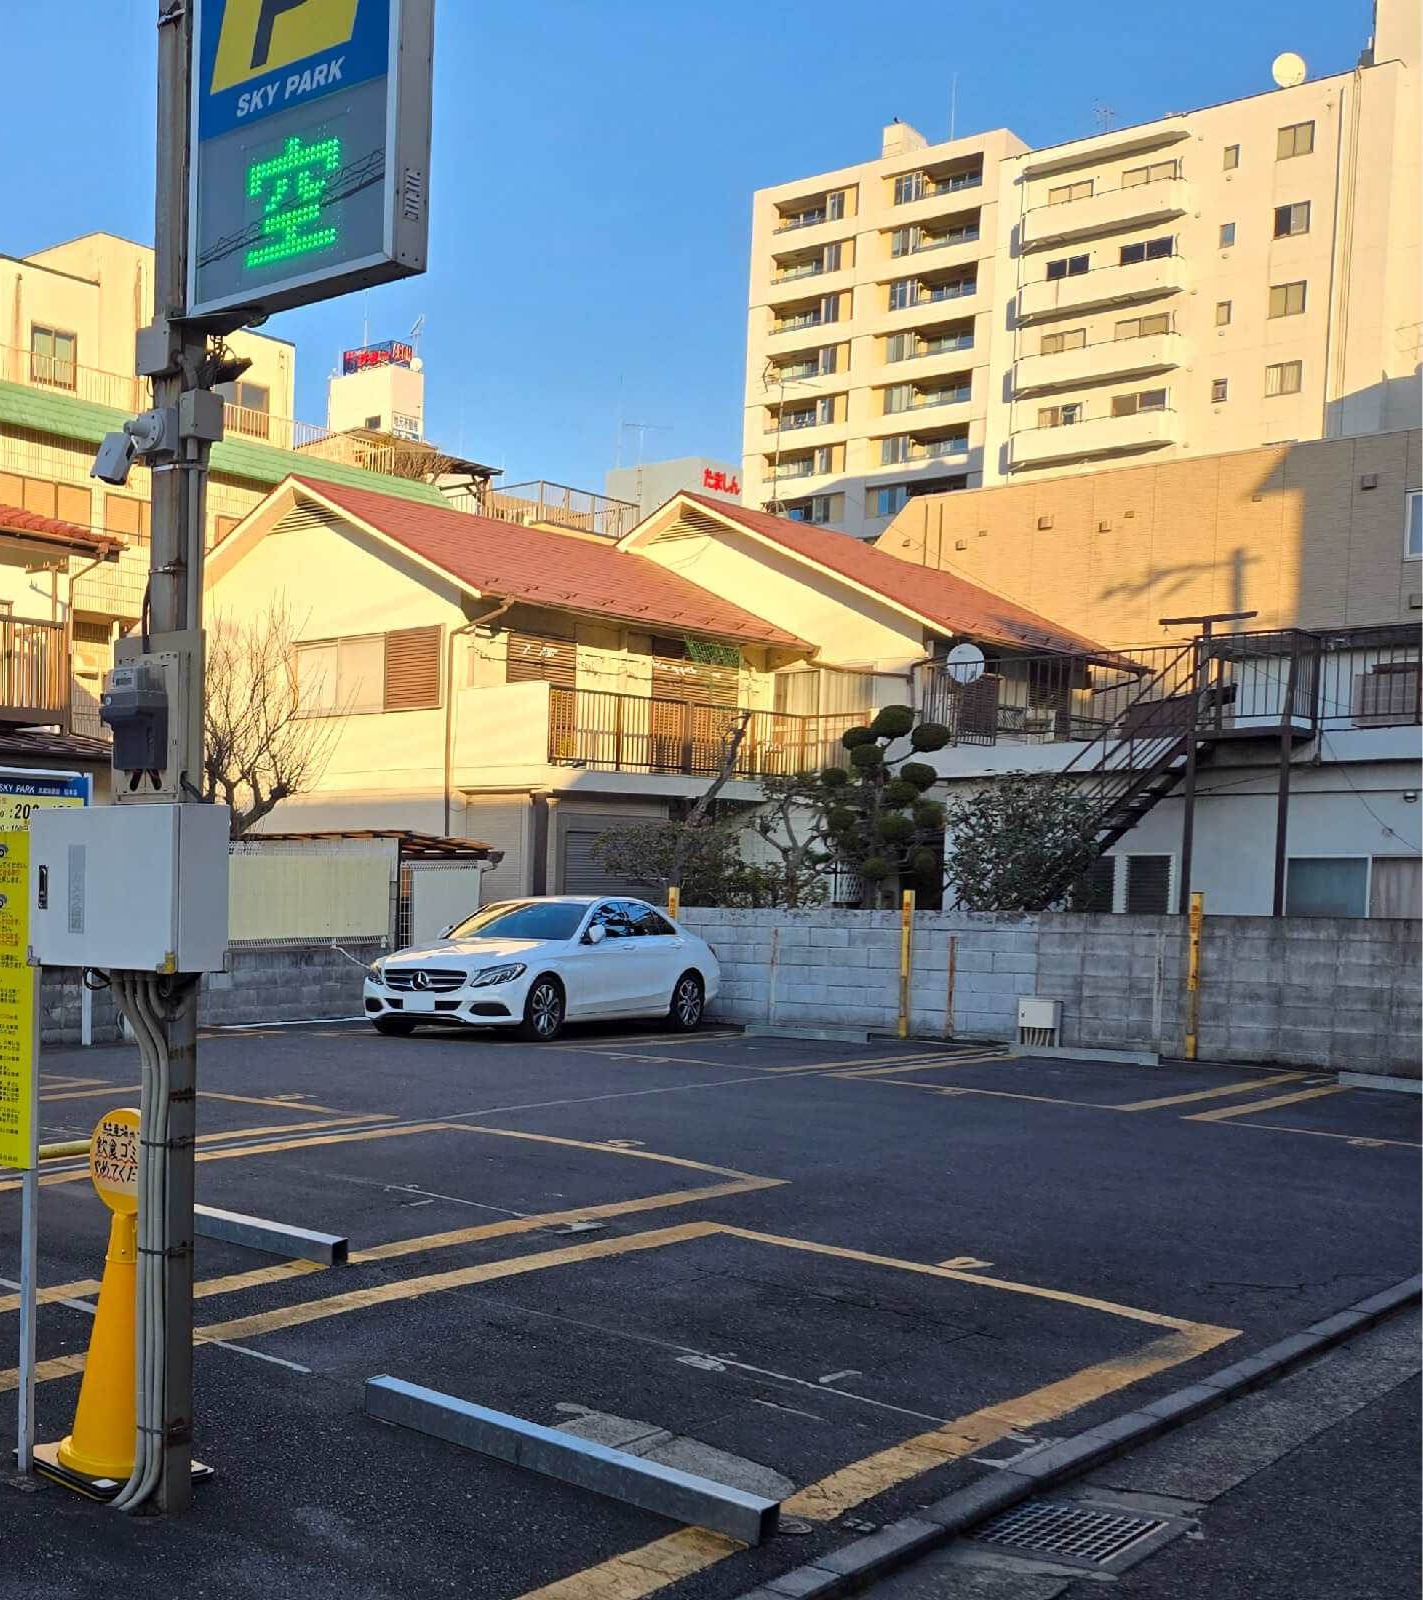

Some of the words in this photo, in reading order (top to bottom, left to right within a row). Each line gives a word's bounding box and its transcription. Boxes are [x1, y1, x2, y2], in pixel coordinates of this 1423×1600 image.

[236, 83, 280, 118] SKY
[284, 56, 346, 100] PARK
[246, 136, 340, 268] 空
[15, 784, 35, 794] PARK
[94, 1160, 138, 1183] やめてくだ
